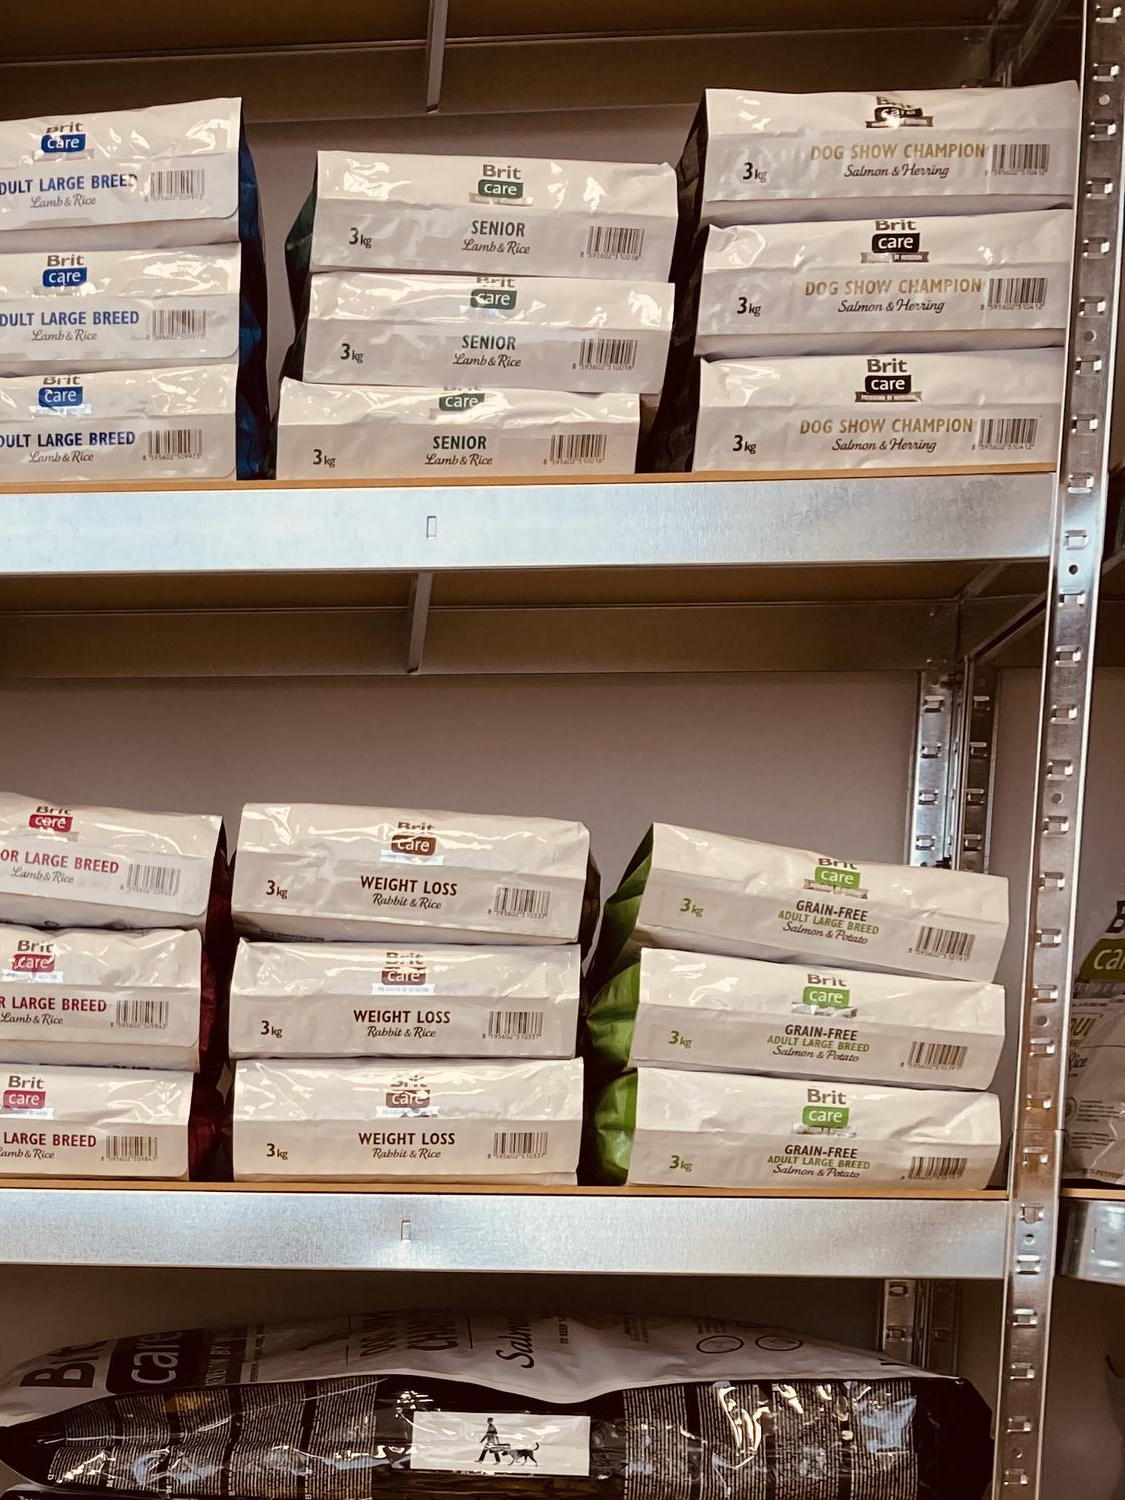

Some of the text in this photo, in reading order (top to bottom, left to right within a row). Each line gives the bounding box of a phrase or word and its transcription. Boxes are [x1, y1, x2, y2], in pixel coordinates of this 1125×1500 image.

[47, 136, 80, 150] care
[811, 143, 986, 160] DOG SHOW CHAMPION
[482, 164, 522, 180] Brit
[39, 176, 84, 193] LARGE
[484, 182, 518, 196] care
[471, 220, 525, 237] SENIOR
[875, 220, 916, 231] Brit
[878, 235, 913, 249] care
[46, 254, 85, 267] Brit
[48, 270, 81, 285] care
[805, 278, 982, 296] DOG SHOW CHAMPION
[477, 291, 511, 306] care
[837, 300, 883, 313] Salmon
[896, 300, 946, 316] Herring
[41, 311, 86, 326] LARGE
[92, 310, 139, 325] BREED
[31, 329, 65, 342] Lamb
[75, 328, 98, 341] Rice
[462, 335, 516, 350] SENIOR
[867, 359, 908, 373] Brit
[870, 377, 905, 391] care
[44, 389, 77, 402] care
[445, 394, 478, 408] care
[799, 417, 974, 434] DOG SHOW CHAMPION
[37, 432, 83, 447] LARGE
[89, 431, 135, 445] BREED
[433, 435, 487, 450] SENIOR
[832, 438, 877, 452] Salmon
[889, 438, 937, 453] Herring
[425, 453, 459, 466] Lamb
[469, 454, 493, 467] Rice
[35, 815, 66, 828] care
[397, 837, 430, 852] care
[25, 851, 68, 868] LARGE
[74, 857, 119, 874] BREED
[818, 857, 858, 870] Brit
[821, 869, 854, 885] care
[360, 875, 458, 896] WEIGHT LOSS
[372, 893, 408, 907] Rabbit
[419, 896, 442, 910] Rice
[796, 899, 868, 922] GRAIN-FREE
[778, 910, 879, 935] ADULT LARGE BREED
[19, 957, 49, 969] care
[807, 973, 847, 987] Brit
[11, 996, 56, 1010] LARGE
[61, 998, 107, 1012] BREED
[809, 989, 843, 1004] care
[353, 1010, 450, 1024] WEIGHT LOSS
[785, 1024, 858, 1041] GRAIN-FREE
[767, 1034, 870, 1052] ADULT LARGE BREED
[773, 1045, 814, 1059] Salmon
[826, 1049, 859, 1063] Potato
[8, 1075, 44, 1090] Brit
[8, 1093, 39, 1106] care
[807, 1089, 847, 1104] Brit
[808, 1108, 843, 1123] care
[3, 1132, 46, 1146] LARGE
[52, 1134, 97, 1148] BREED
[358, 1132, 456, 1146] WEIGHT LOSS
[33, 1148, 55, 1160] Rice
[372, 1148, 407, 1159] Rabbit
[419, 1148, 442, 1159] Rice
[784, 1144, 858, 1159] GRAIN-FREE
[767, 1155, 870, 1170] ADULT LARGE BREED
